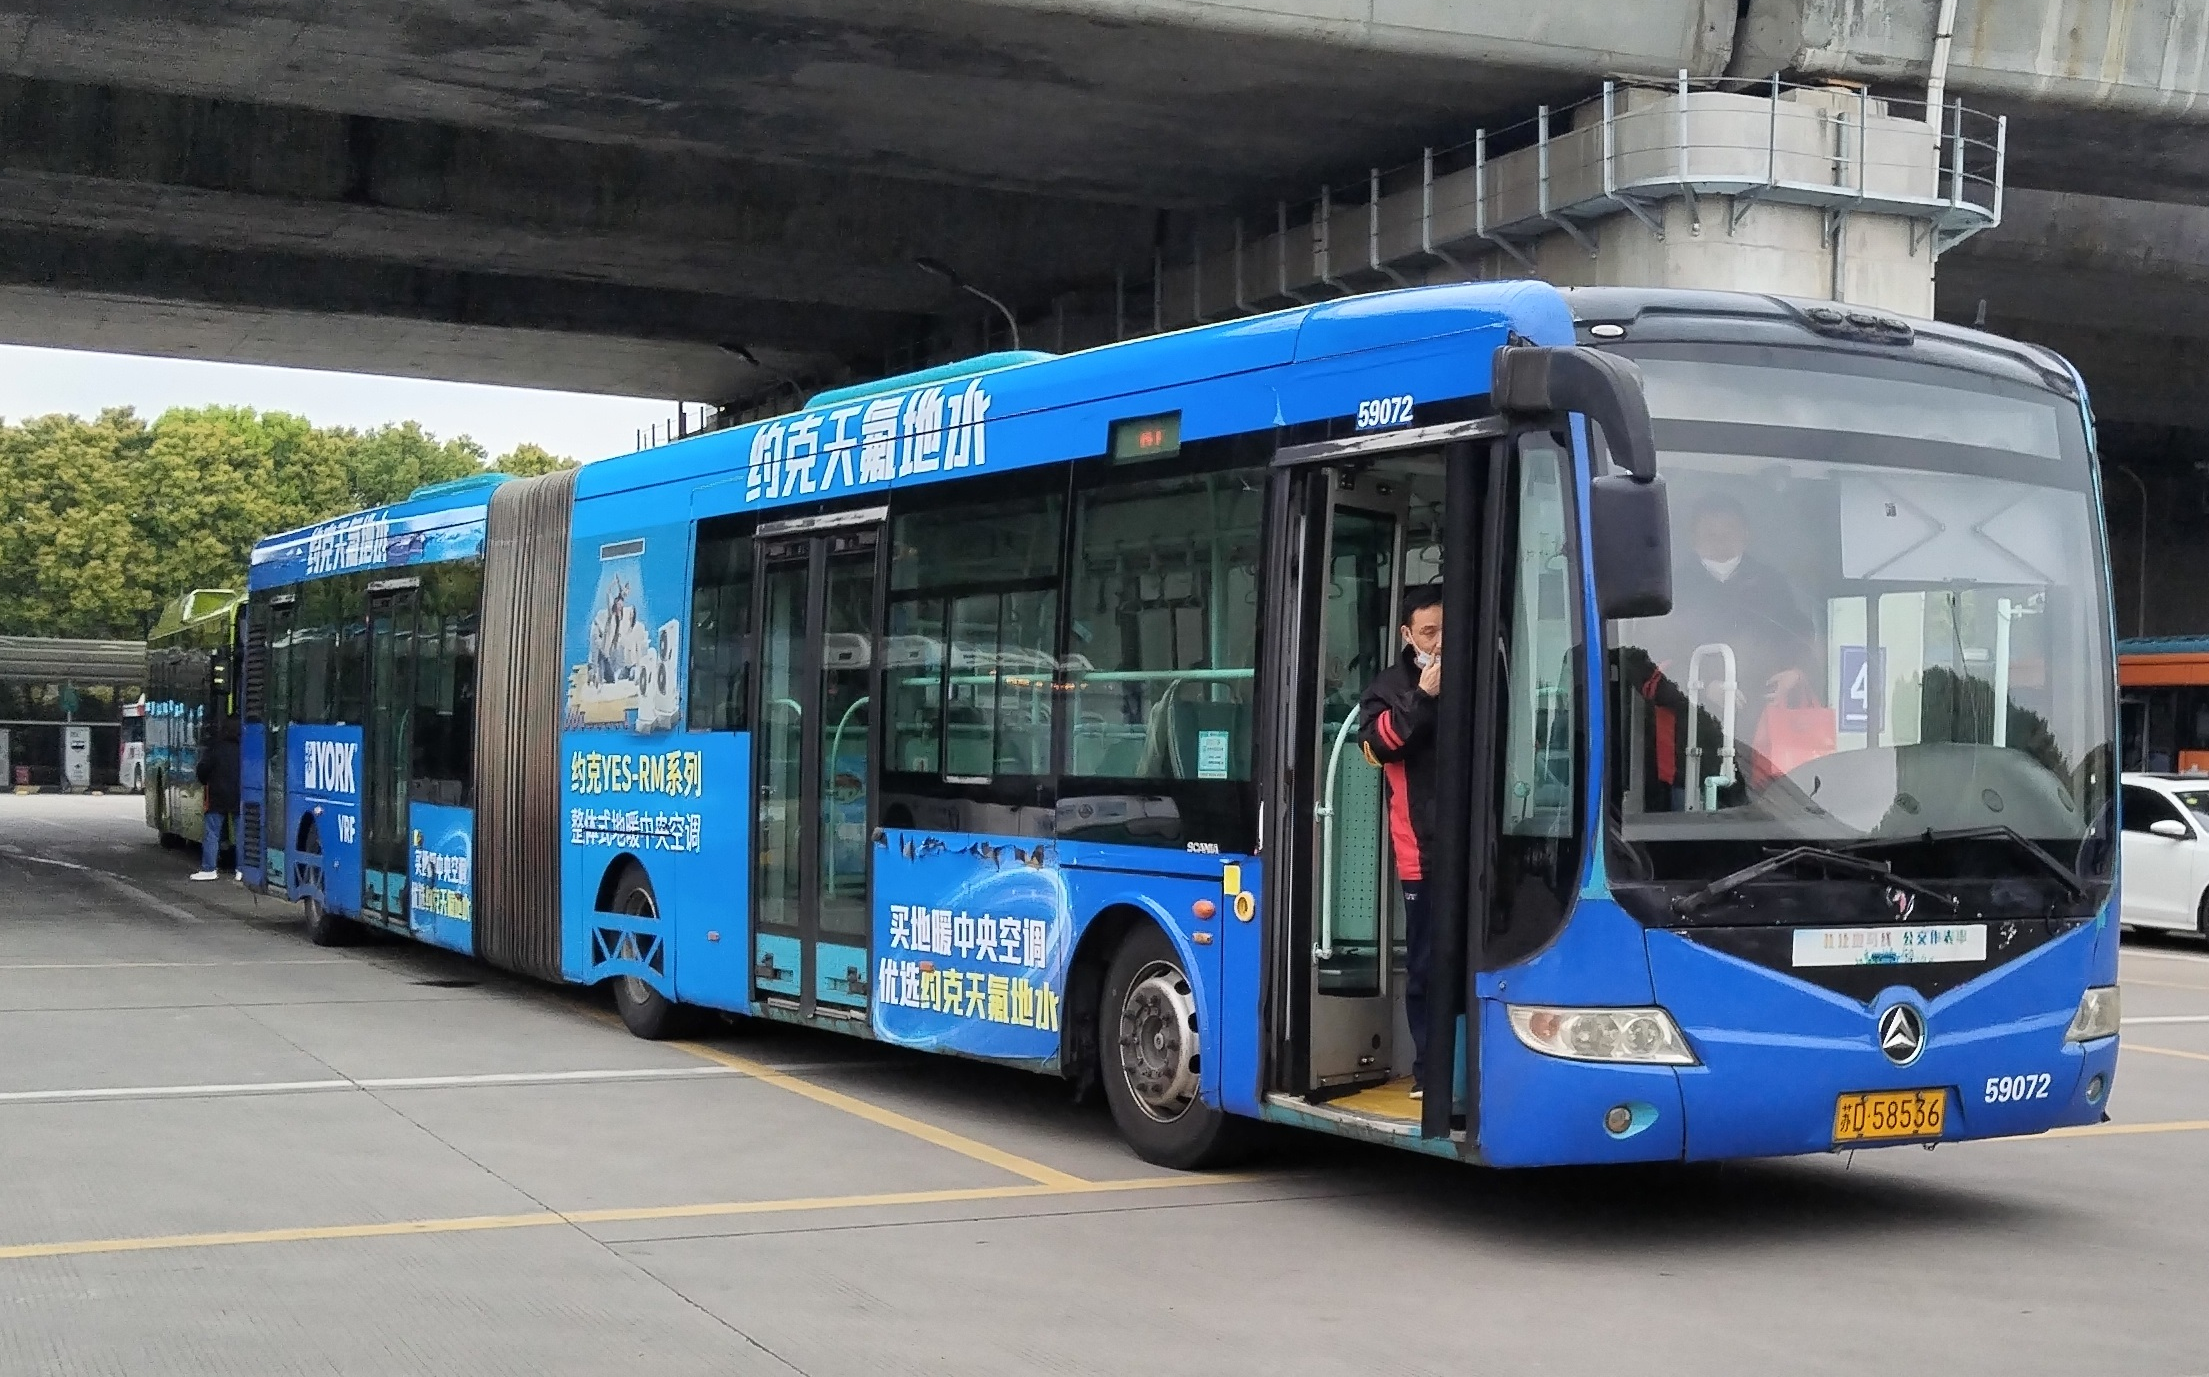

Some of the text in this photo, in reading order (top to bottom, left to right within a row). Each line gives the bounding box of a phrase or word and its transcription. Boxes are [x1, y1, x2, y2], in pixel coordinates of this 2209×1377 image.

[1357, 394, 1415, 429] 59072
[316, 741, 357, 794] YORK
[570, 750, 703, 798] 约克YES-RM系列
[337, 813, 356, 844] VRF
[570, 807, 702, 853] 整体式地暖中央空调
[1186, 841, 1220, 855] SCANIA
[889, 904, 1047, 970] 买地暖中央空调
[1984, 1072, 2052, 1104] 59072
